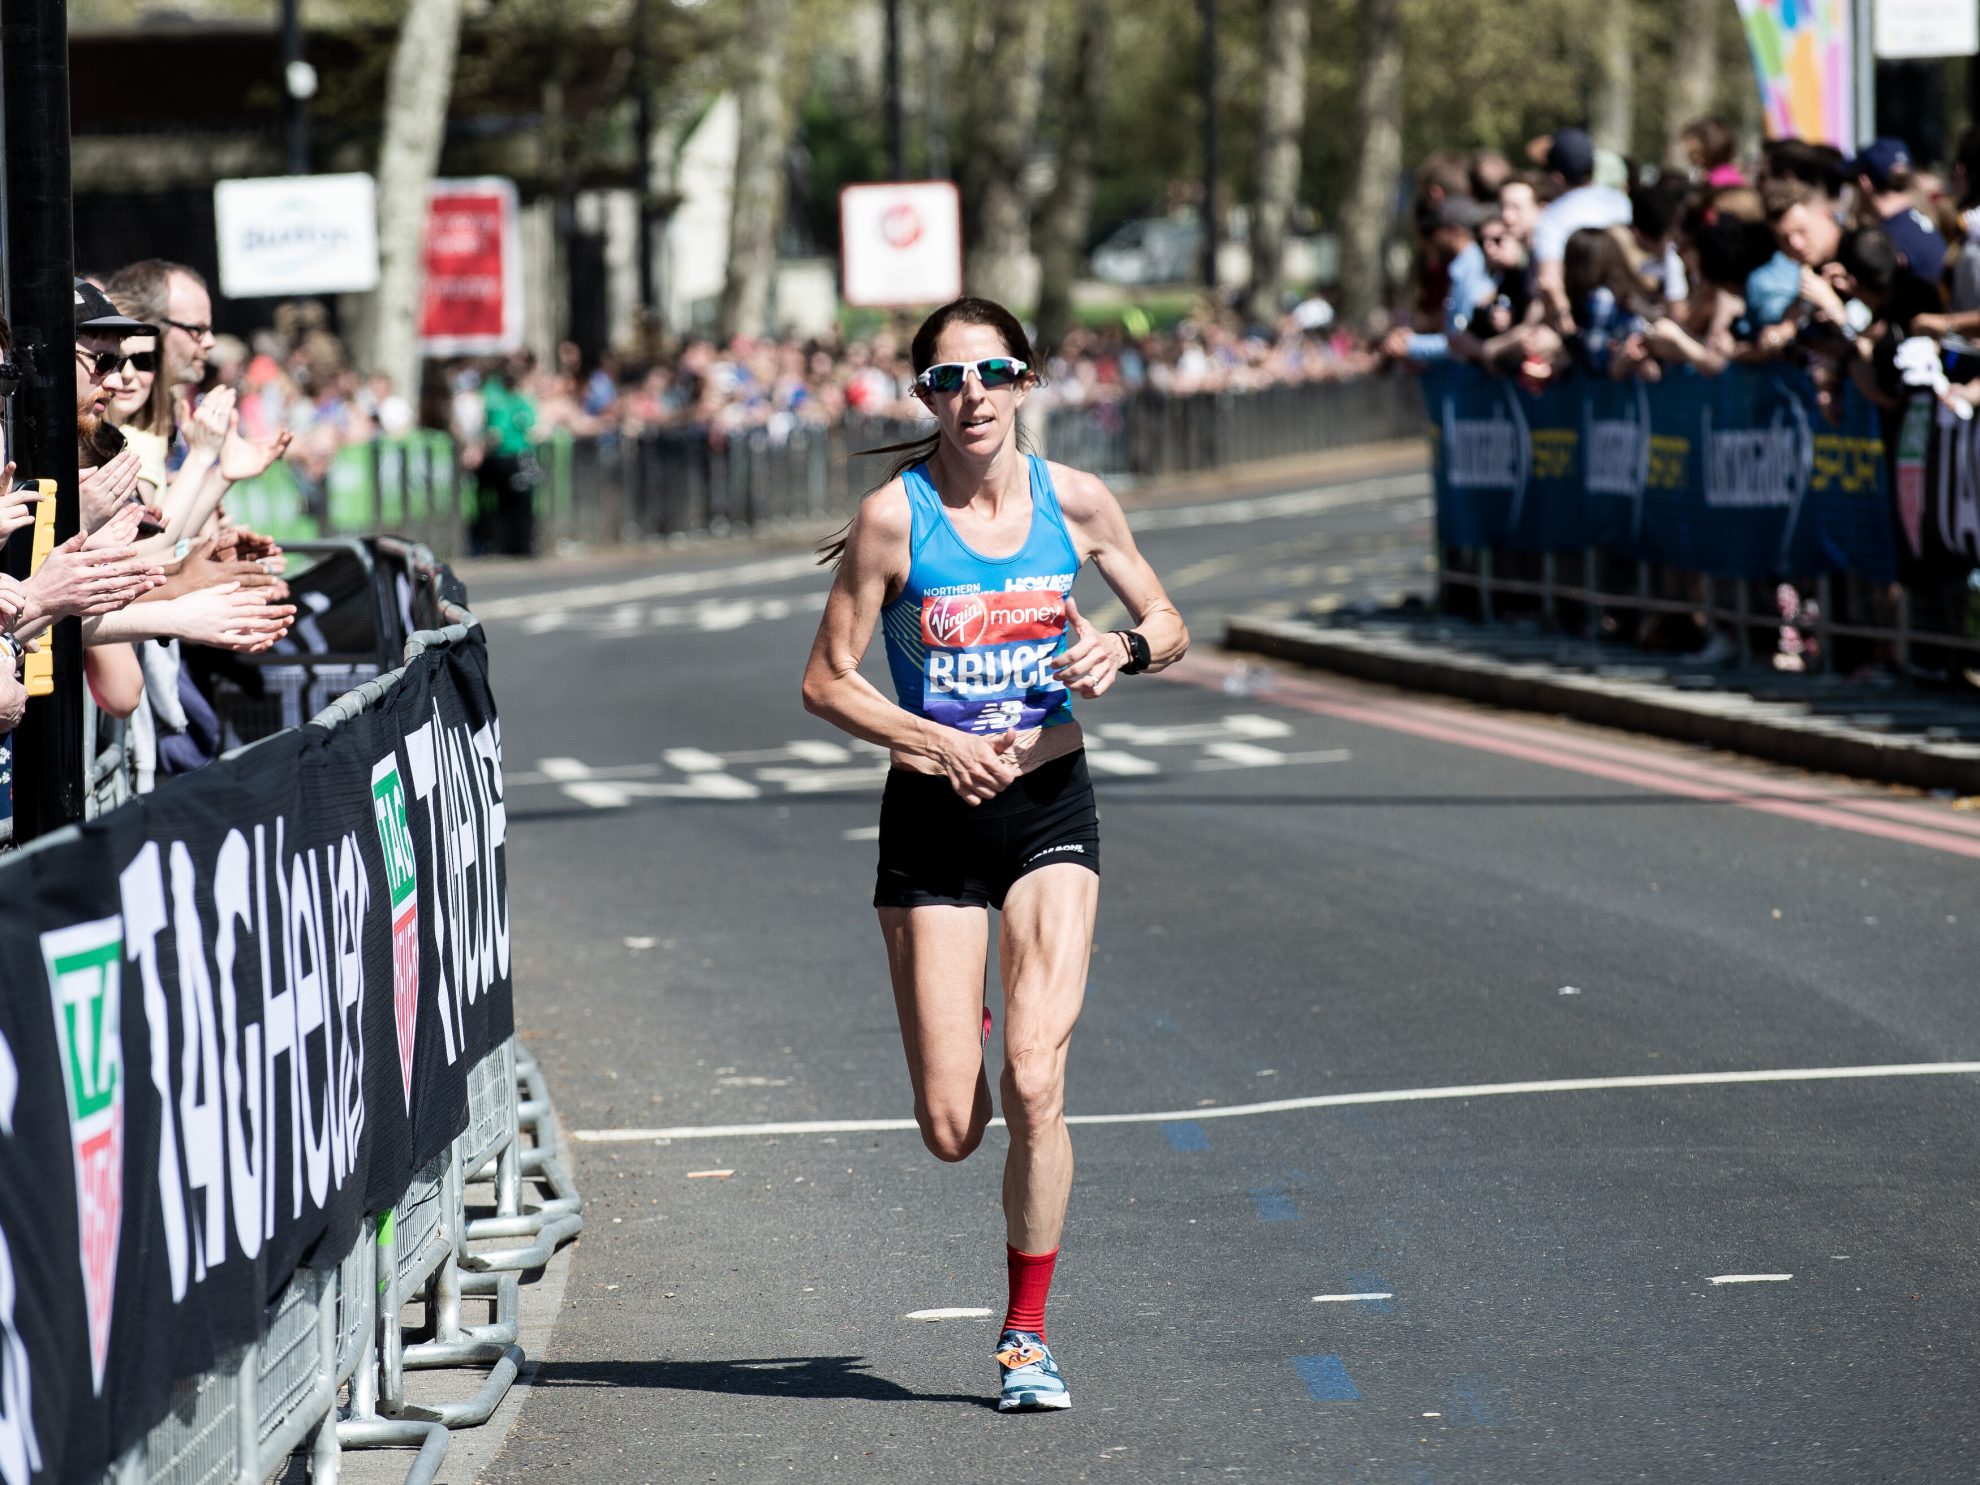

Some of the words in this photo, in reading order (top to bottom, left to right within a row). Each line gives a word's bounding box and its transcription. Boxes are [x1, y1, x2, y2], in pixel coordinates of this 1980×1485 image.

[923, 583, 981, 597] NORTHERN
[931, 597, 983, 643] Virgin
[990, 604, 1062, 625] money
[929, 642, 1057, 694] BRUCE
[375, 784, 415, 891] TAG
